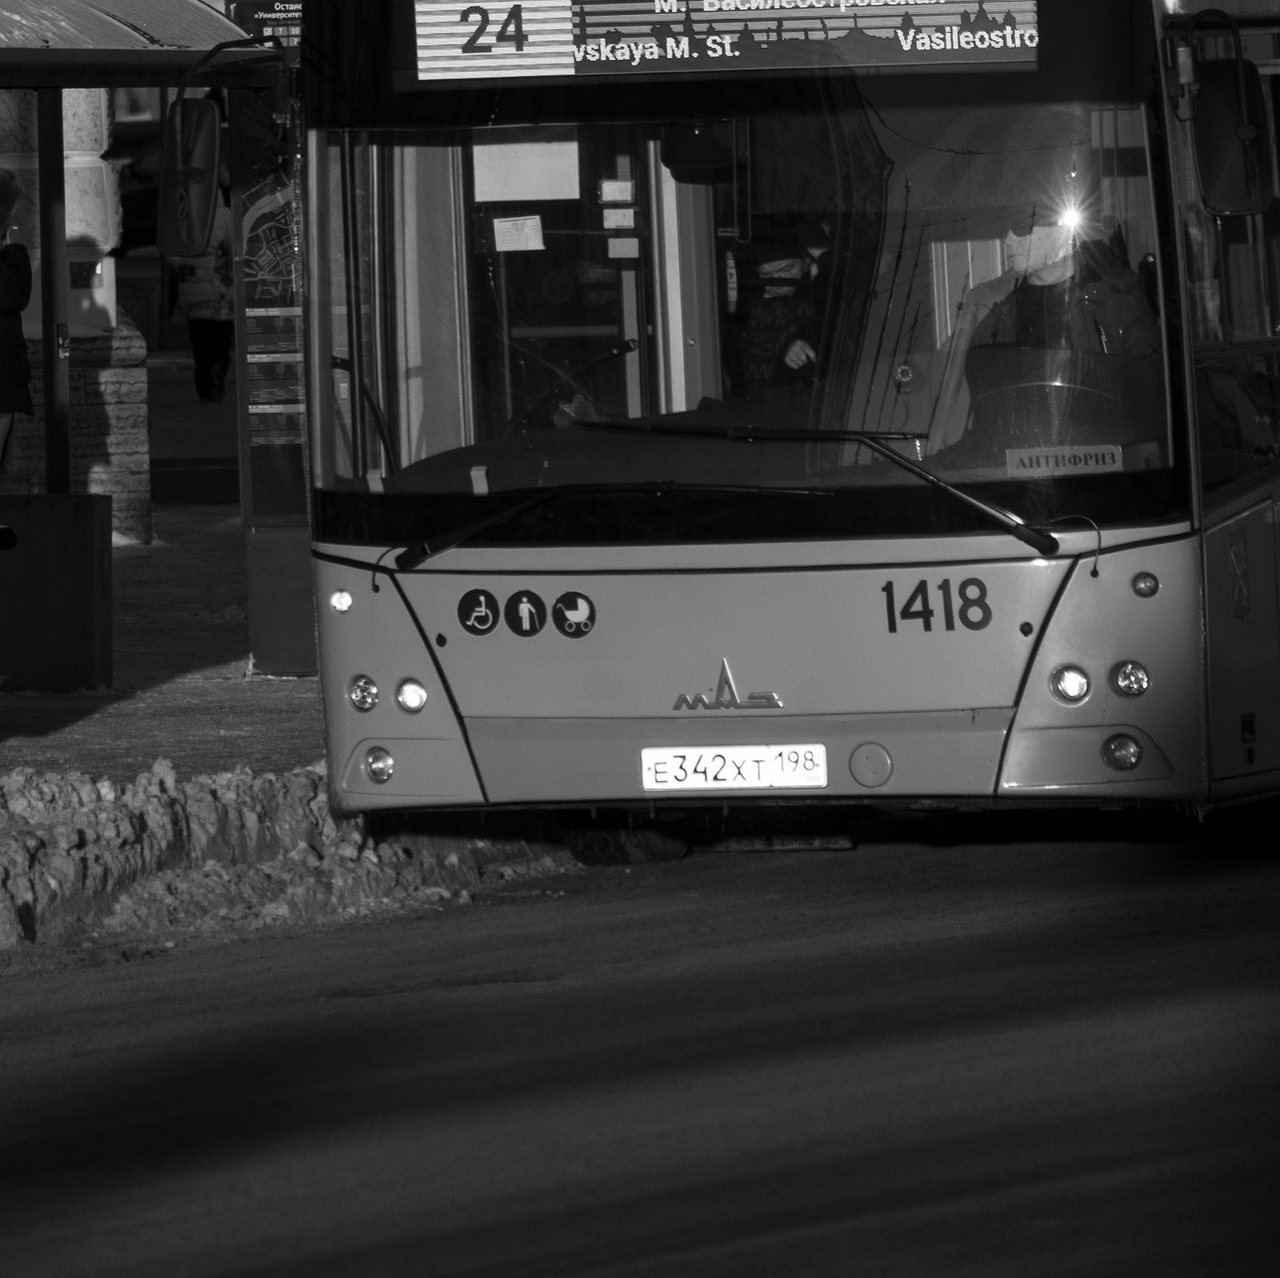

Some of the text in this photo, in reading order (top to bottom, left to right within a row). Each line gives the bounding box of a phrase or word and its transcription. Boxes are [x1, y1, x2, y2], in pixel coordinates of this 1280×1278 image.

[459, 4, 529, 54] 24
[896, 25, 1040, 52] Vasileostro
[666, 36, 700, 59] M.
[705, 35, 741, 58] St.
[1015, 452, 1117, 470] АНТИФРИЗ
[881, 577, 993, 634] 1418
